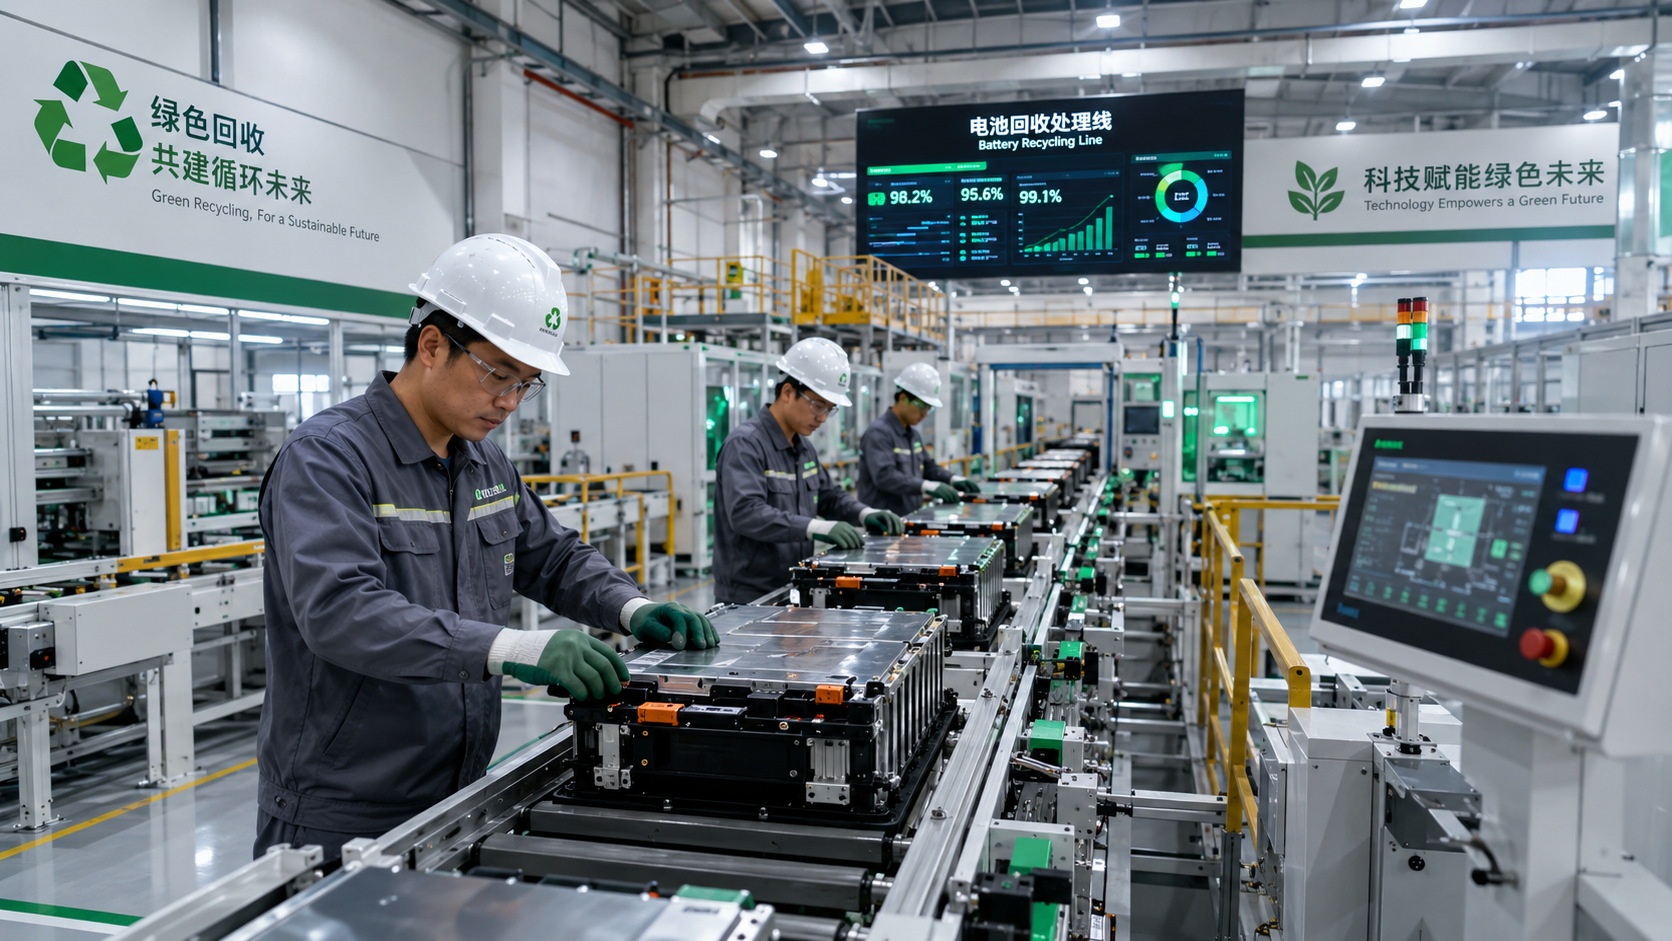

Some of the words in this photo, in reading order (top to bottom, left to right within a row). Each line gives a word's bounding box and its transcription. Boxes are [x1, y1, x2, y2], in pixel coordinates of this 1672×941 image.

[150, 95, 265, 156] 绿色回收
[970, 110, 1113, 137] 电池回收处理线
[978, 139, 1020, 152] Battery
[1021, 135, 1076, 150] Recycling
[1078, 134, 1103, 146] Line
[151, 142, 313, 204] 共建循环未来
[1363, 158, 1606, 194] 科技赋能绿色未来
[889, 189, 933, 205] 98.2%
[960, 186, 1004, 202] 95.6%
[1018, 188, 1063, 205] 99.1%
[1364, 198, 1435, 212] Technology
[1438, 197, 1504, 211] Empowers
[1507, 198, 1515, 207] a
[1518, 194, 1558, 207] Green
[1561, 193, 1604, 206] Future
[151, 189, 190, 208] Green
[194, 196, 253, 222] Recycling,
[257, 209, 275, 223] For
[278, 215, 285, 225] a
[288, 215, 347, 236] Sustainable
[350, 225, 380, 242] Future
